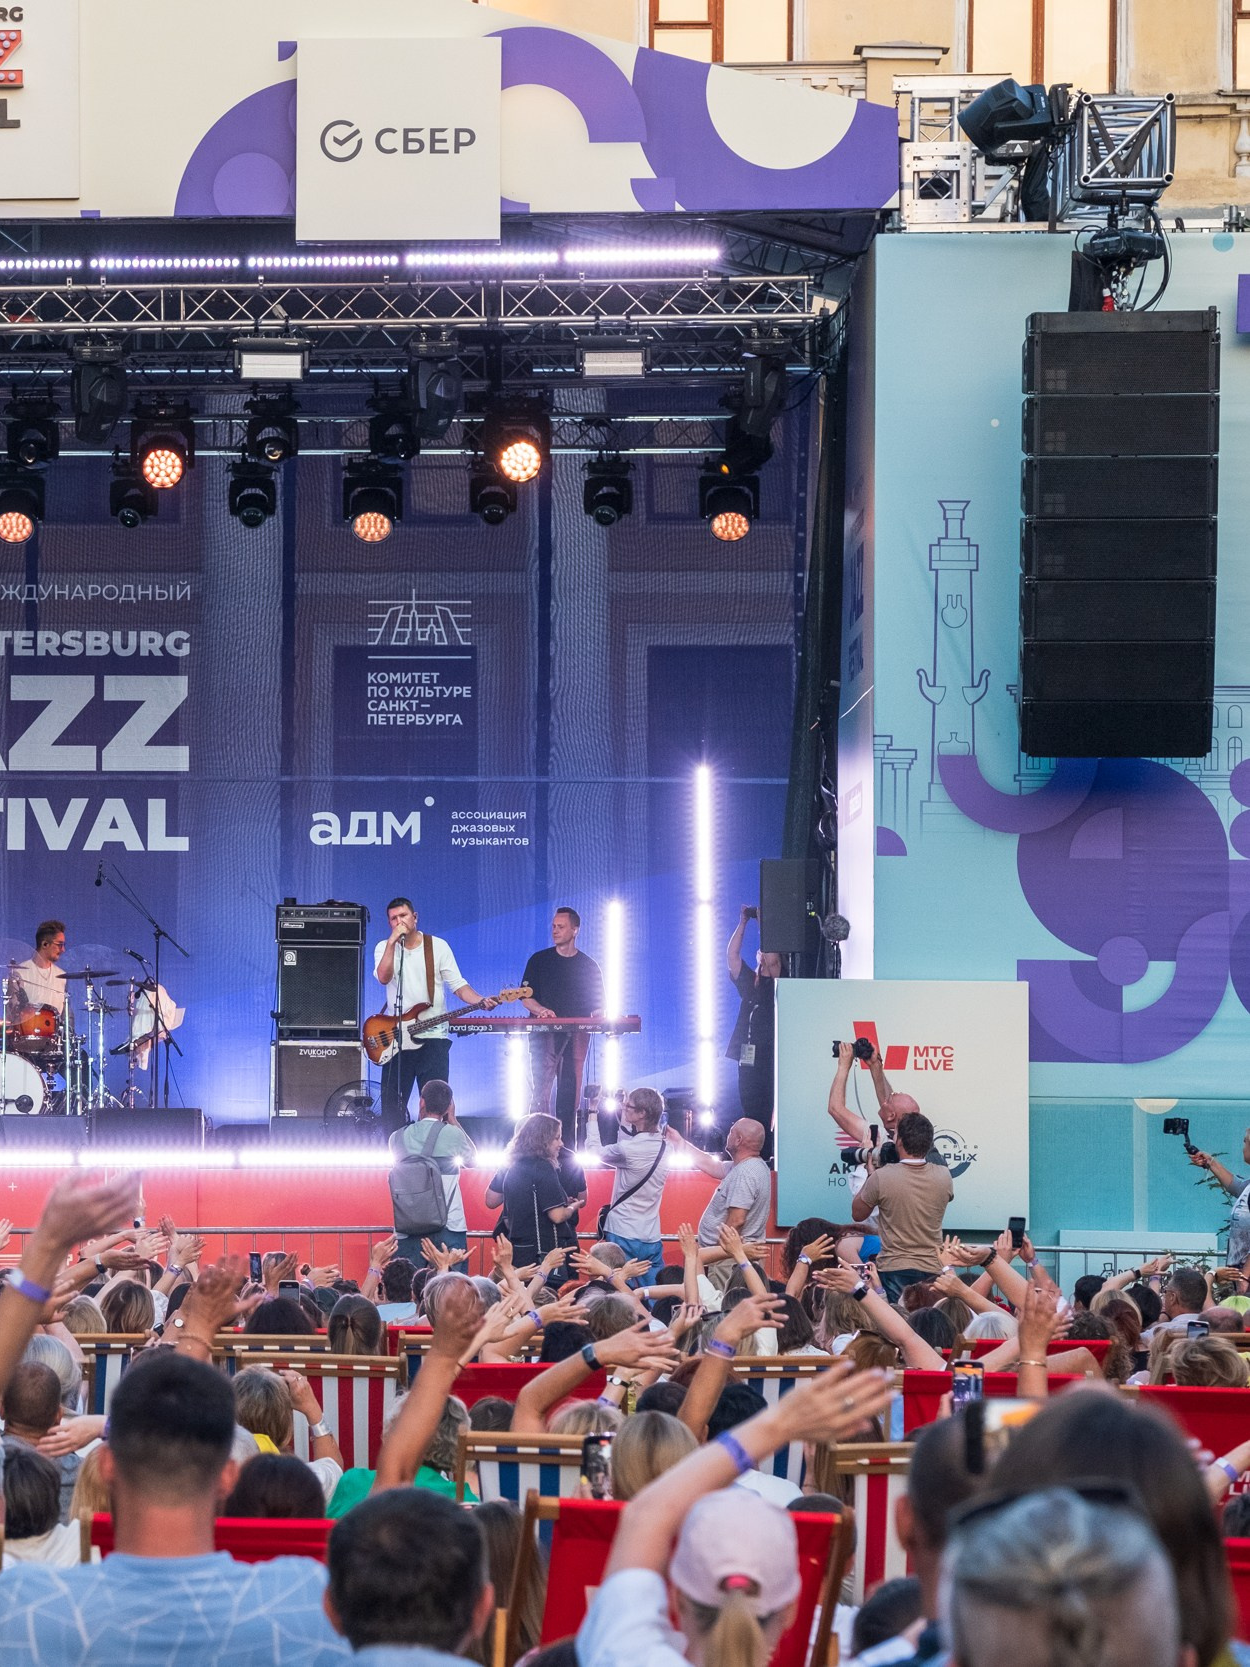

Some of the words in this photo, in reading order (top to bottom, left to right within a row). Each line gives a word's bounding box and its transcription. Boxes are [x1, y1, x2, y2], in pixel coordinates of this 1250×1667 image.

[375, 127, 476, 154] СБЕР
[367, 672, 440, 684] КОМИТЕТ
[367, 686, 390, 698] ПО
[394, 686, 472, 698] КУЛЬТУРЕ
[367, 713, 463, 725] ПЕТЕРБУРГА
[451, 810, 527, 821] ассоциация
[309, 811, 421, 846] адм
[451, 824, 516, 834] джазовых
[451, 837, 530, 848] музыкантов
[299, 1048, 337, 1056] ZVUKOHOD
[913, 1059, 954, 1071] LIVE
